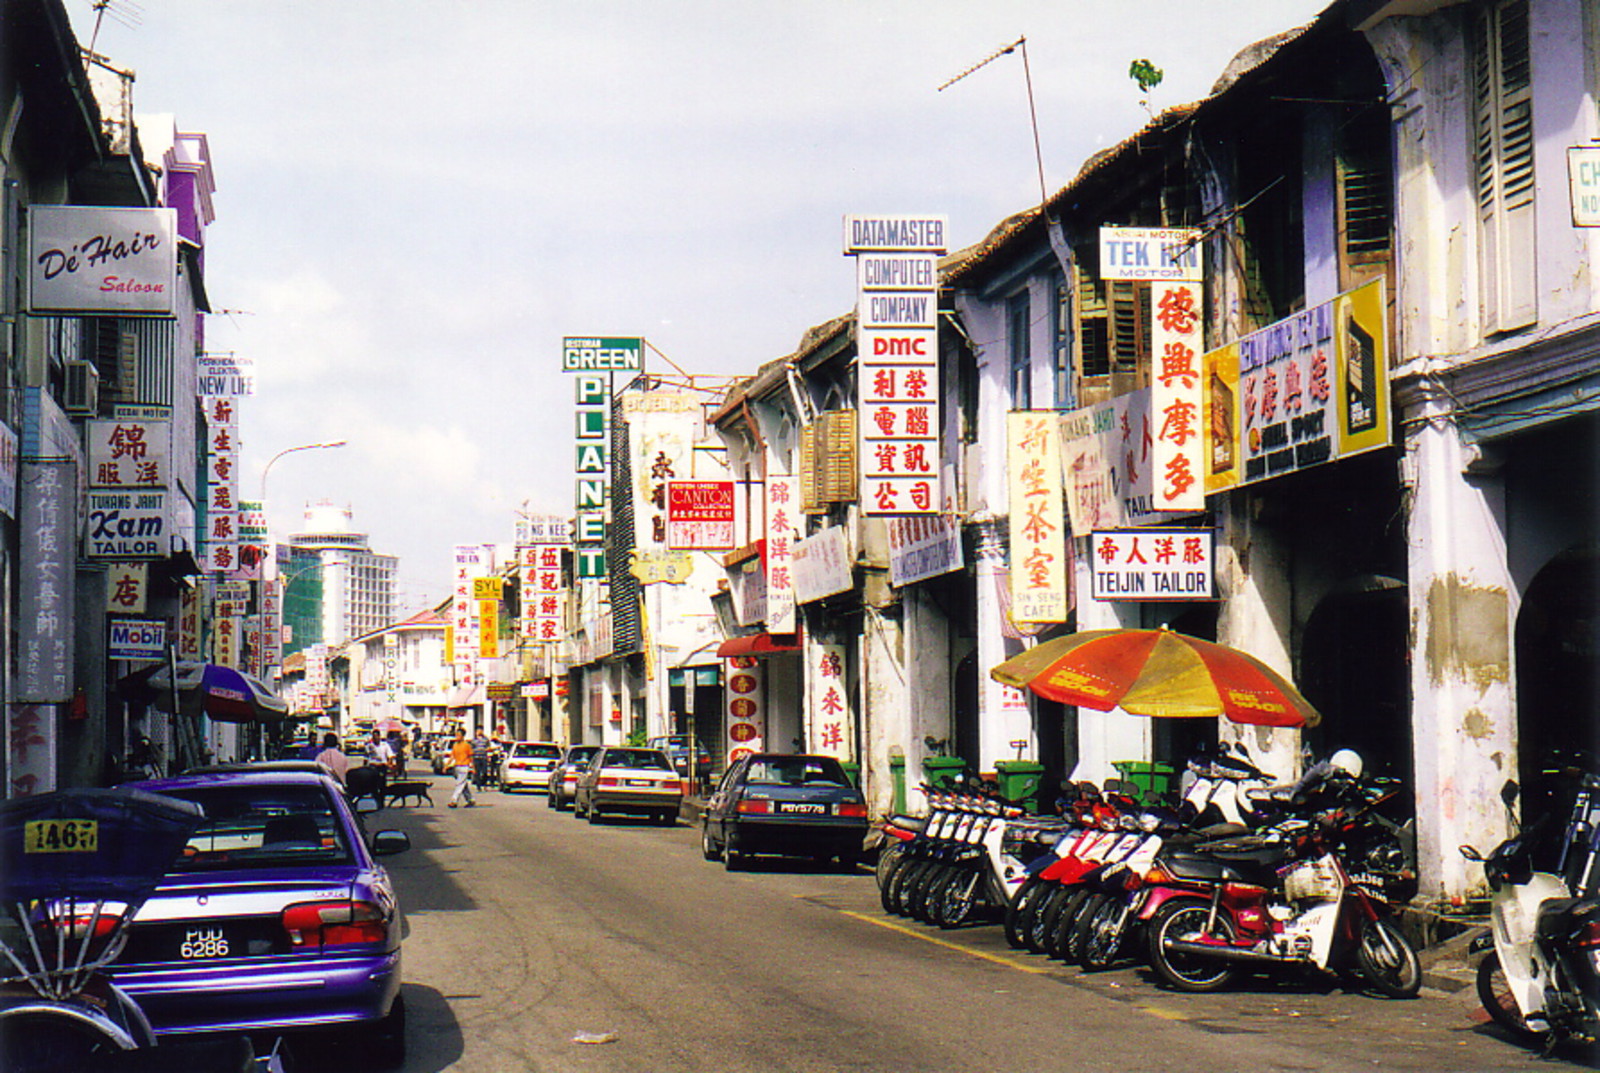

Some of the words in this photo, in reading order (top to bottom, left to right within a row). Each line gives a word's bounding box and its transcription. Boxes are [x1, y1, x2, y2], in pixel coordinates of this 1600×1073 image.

[852, 219, 944, 247] DATAMASTER
[1105, 241, 1149, 267] TEK
[864, 259, 932, 286] COMPUTER
[1120, 269, 1184, 277] MOTOR
[99, 276, 165, 293] Saloon
[871, 297, 928, 323] COMPANY
[565, 348, 639, 369] GREEN
[198, 376, 227, 395] NEW
[230, 376, 254, 395] LIFE
[142, 407, 170, 418] MOTOR
[579, 378, 603, 577] PLANET
[91, 494, 132, 510] TUKANG
[134, 494, 163, 510] JAHIT
[671, 489, 733, 504] CANTON
[873, 481, 931, 511] 公司
[89, 509, 163, 540] Kam
[549, 524, 567, 536] KEE
[92, 541, 159, 554] TAILOR
[1097, 536, 1206, 566] 帝人洋服
[473, 579, 501, 592] SYL
[1097, 572, 1145, 593] TEIJIN
[1151, 572, 1207, 593] TAILOR
[1016, 592, 1034, 603] SIN
[1036, 592, 1062, 603] SENG
[112, 628, 163, 645] Mobil
[180, 940, 230, 958] 6286
